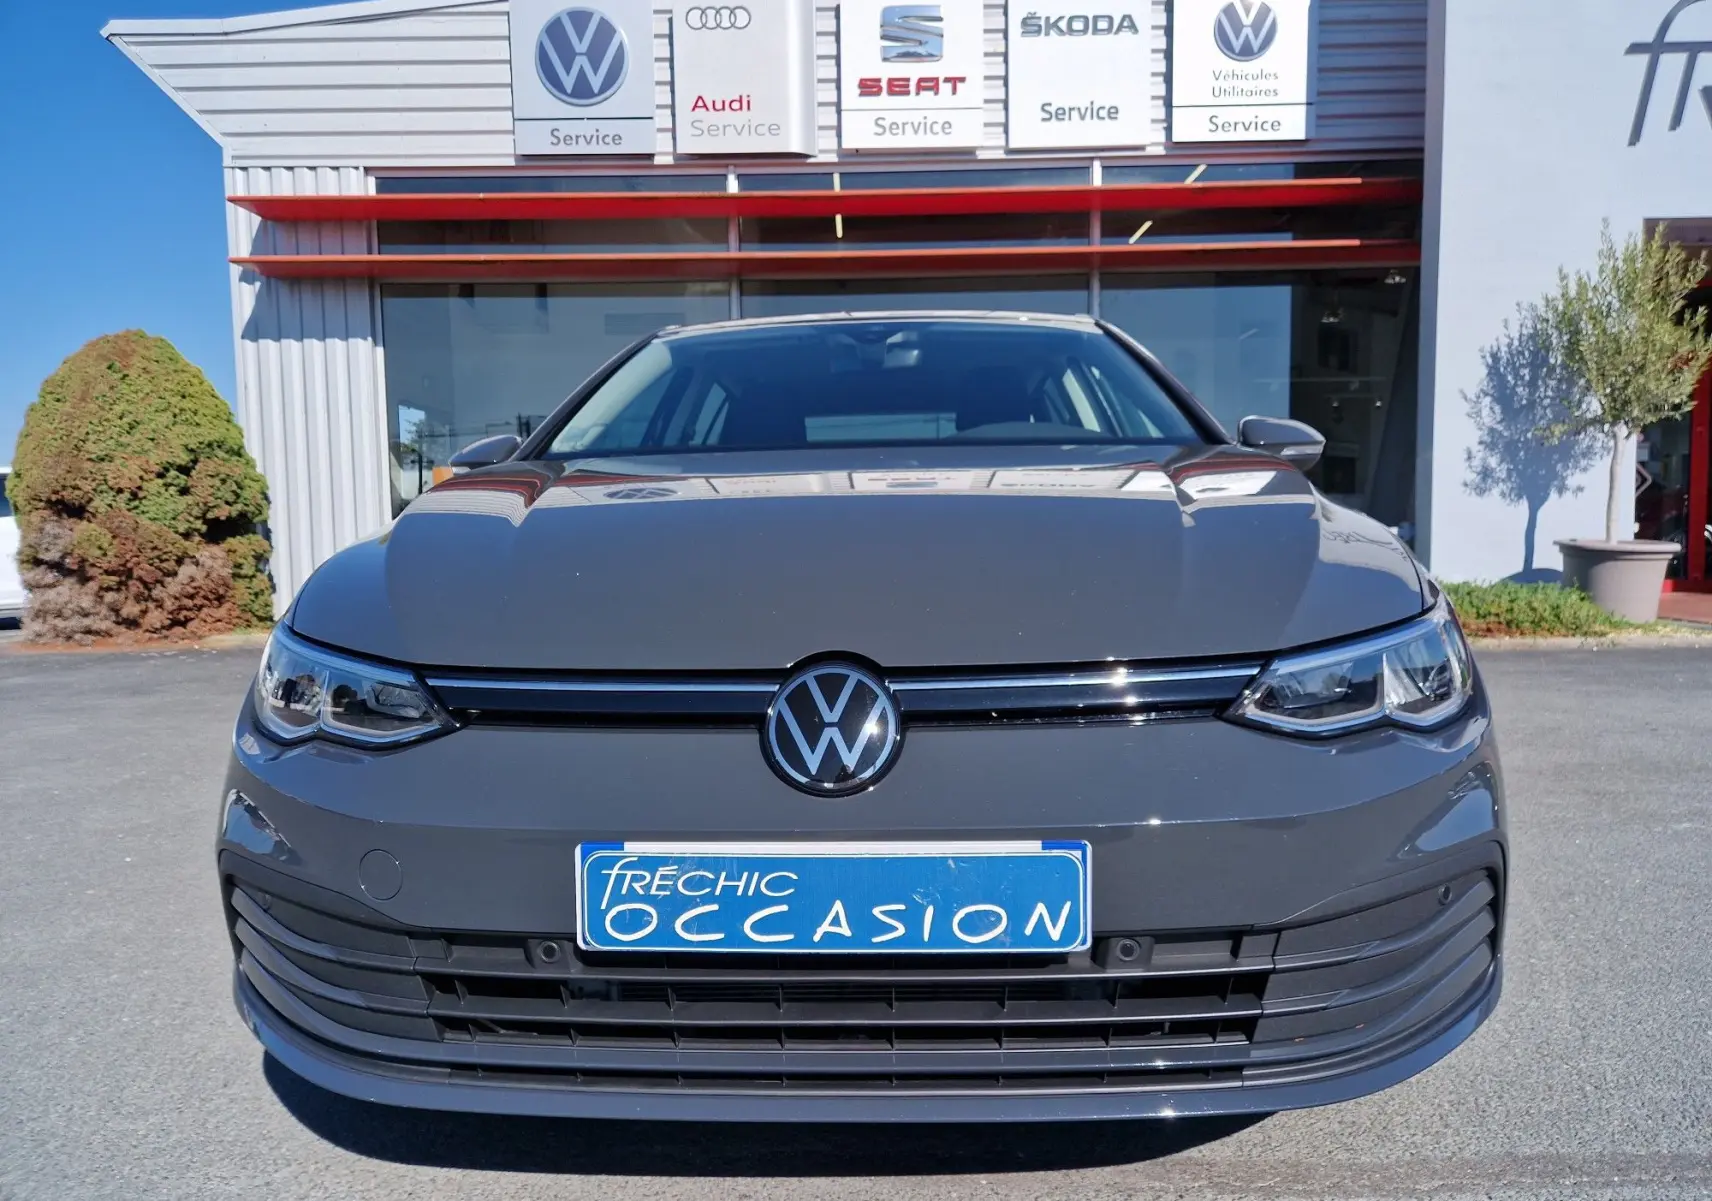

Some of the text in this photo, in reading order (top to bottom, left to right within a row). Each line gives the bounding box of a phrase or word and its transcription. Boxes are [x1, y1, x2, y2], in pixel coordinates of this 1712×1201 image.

[1020, 11, 1139, 38] ŠKODA
[1212, 68, 1279, 81] Véhicules
[857, 76, 967, 97] SEAT
[1212, 85, 1279, 98] Utilitaires
[691, 95, 752, 112] Audi
[1040, 101, 1120, 122] Service
[690, 119, 781, 137] Service
[873, 116, 953, 137] Service
[1208, 114, 1281, 133] Service
[550, 128, 623, 147] Service
[603, 899, 1072, 943] OCCASION
